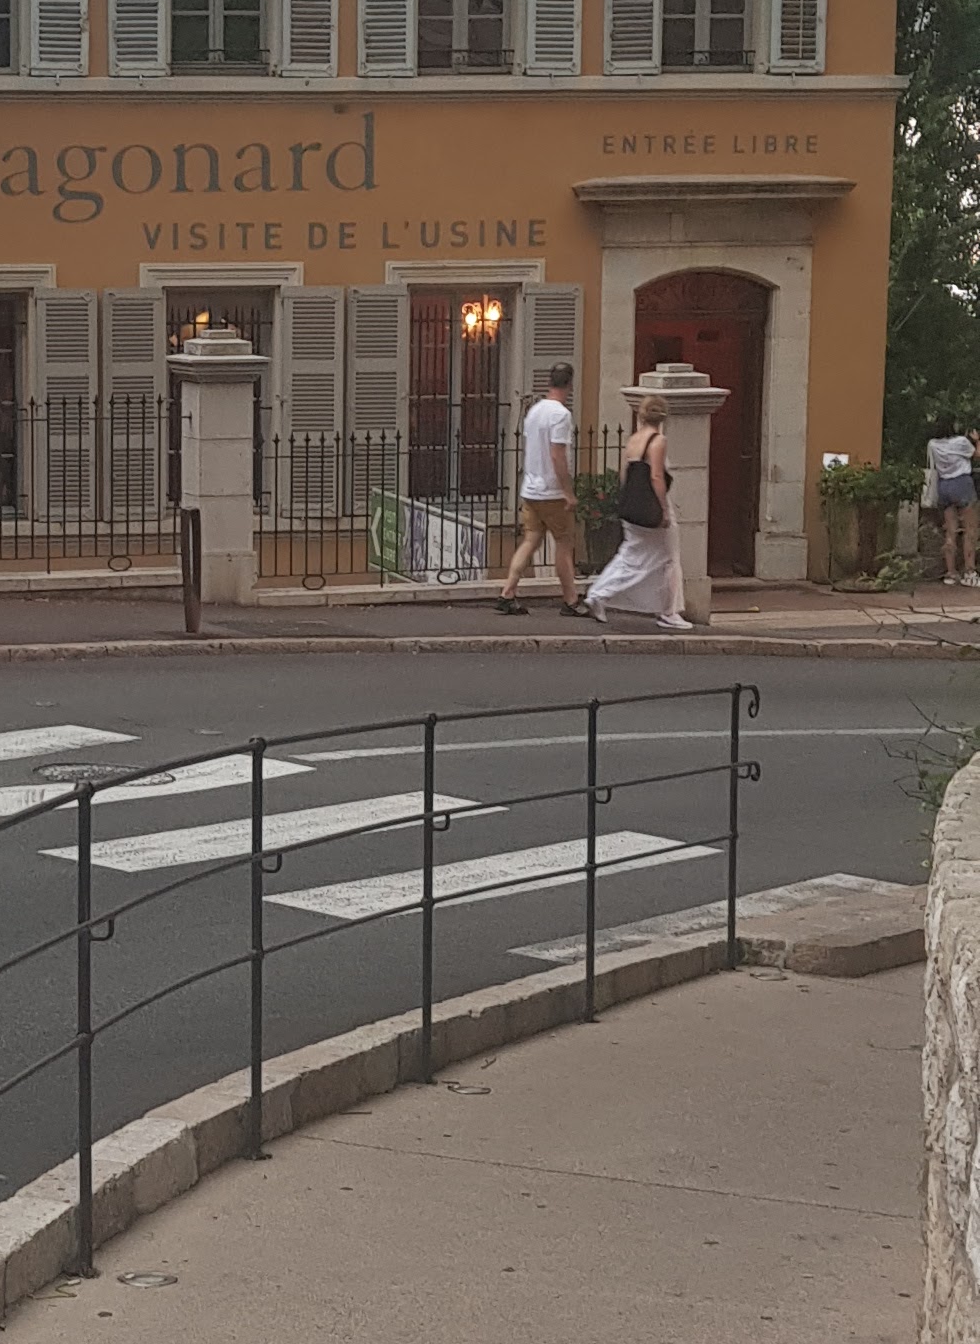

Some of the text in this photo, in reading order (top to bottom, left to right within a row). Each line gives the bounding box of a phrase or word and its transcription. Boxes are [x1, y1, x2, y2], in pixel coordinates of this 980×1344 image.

[602, 129, 819, 155] ENTRÉE LIBRE
[142, 218, 548, 251] VISITE DE L'USINE
